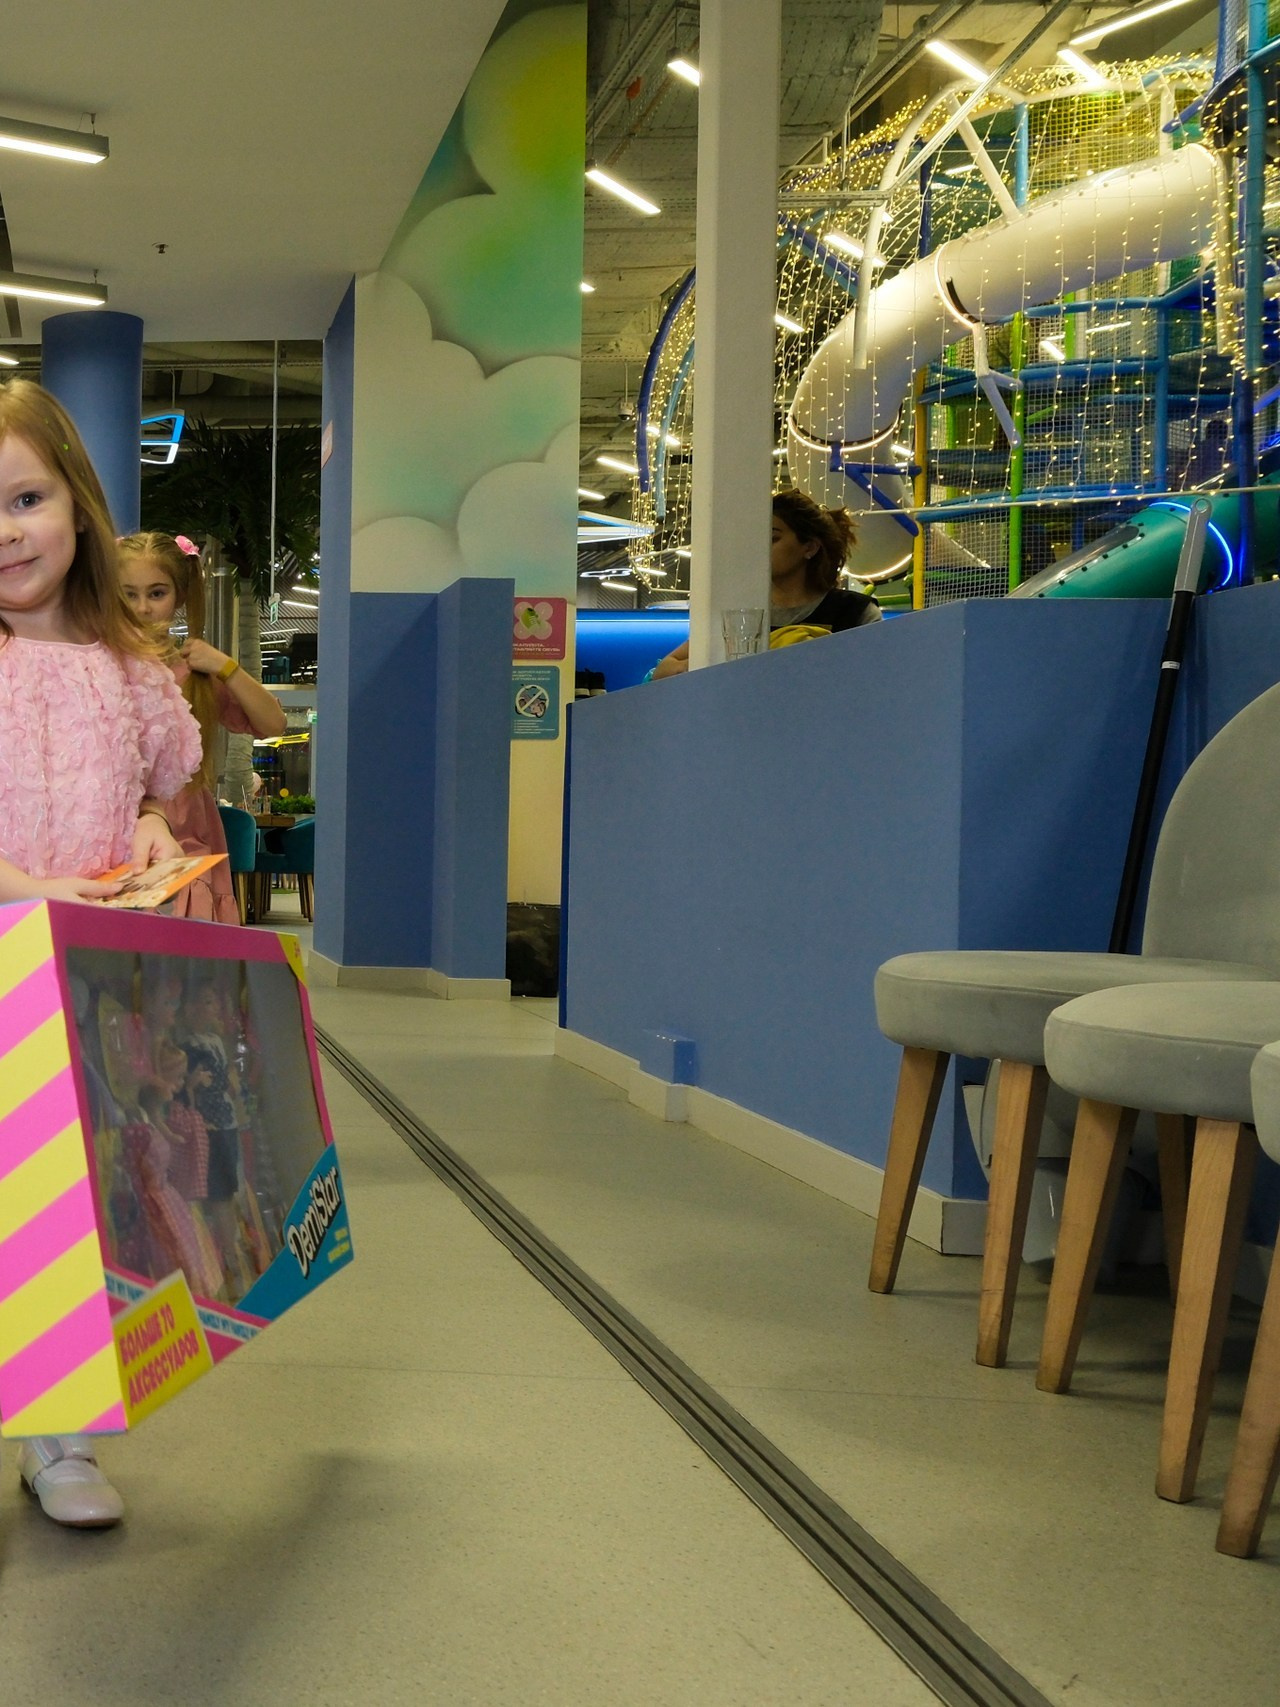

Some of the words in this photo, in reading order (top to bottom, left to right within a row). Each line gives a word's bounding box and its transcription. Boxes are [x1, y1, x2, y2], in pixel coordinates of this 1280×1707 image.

[287, 1166, 341, 1279] DemiStar
[120, 1311, 163, 1368] БОЛЬШЕ
[128, 1327, 200, 1409] АКСЕССУАРОВ
